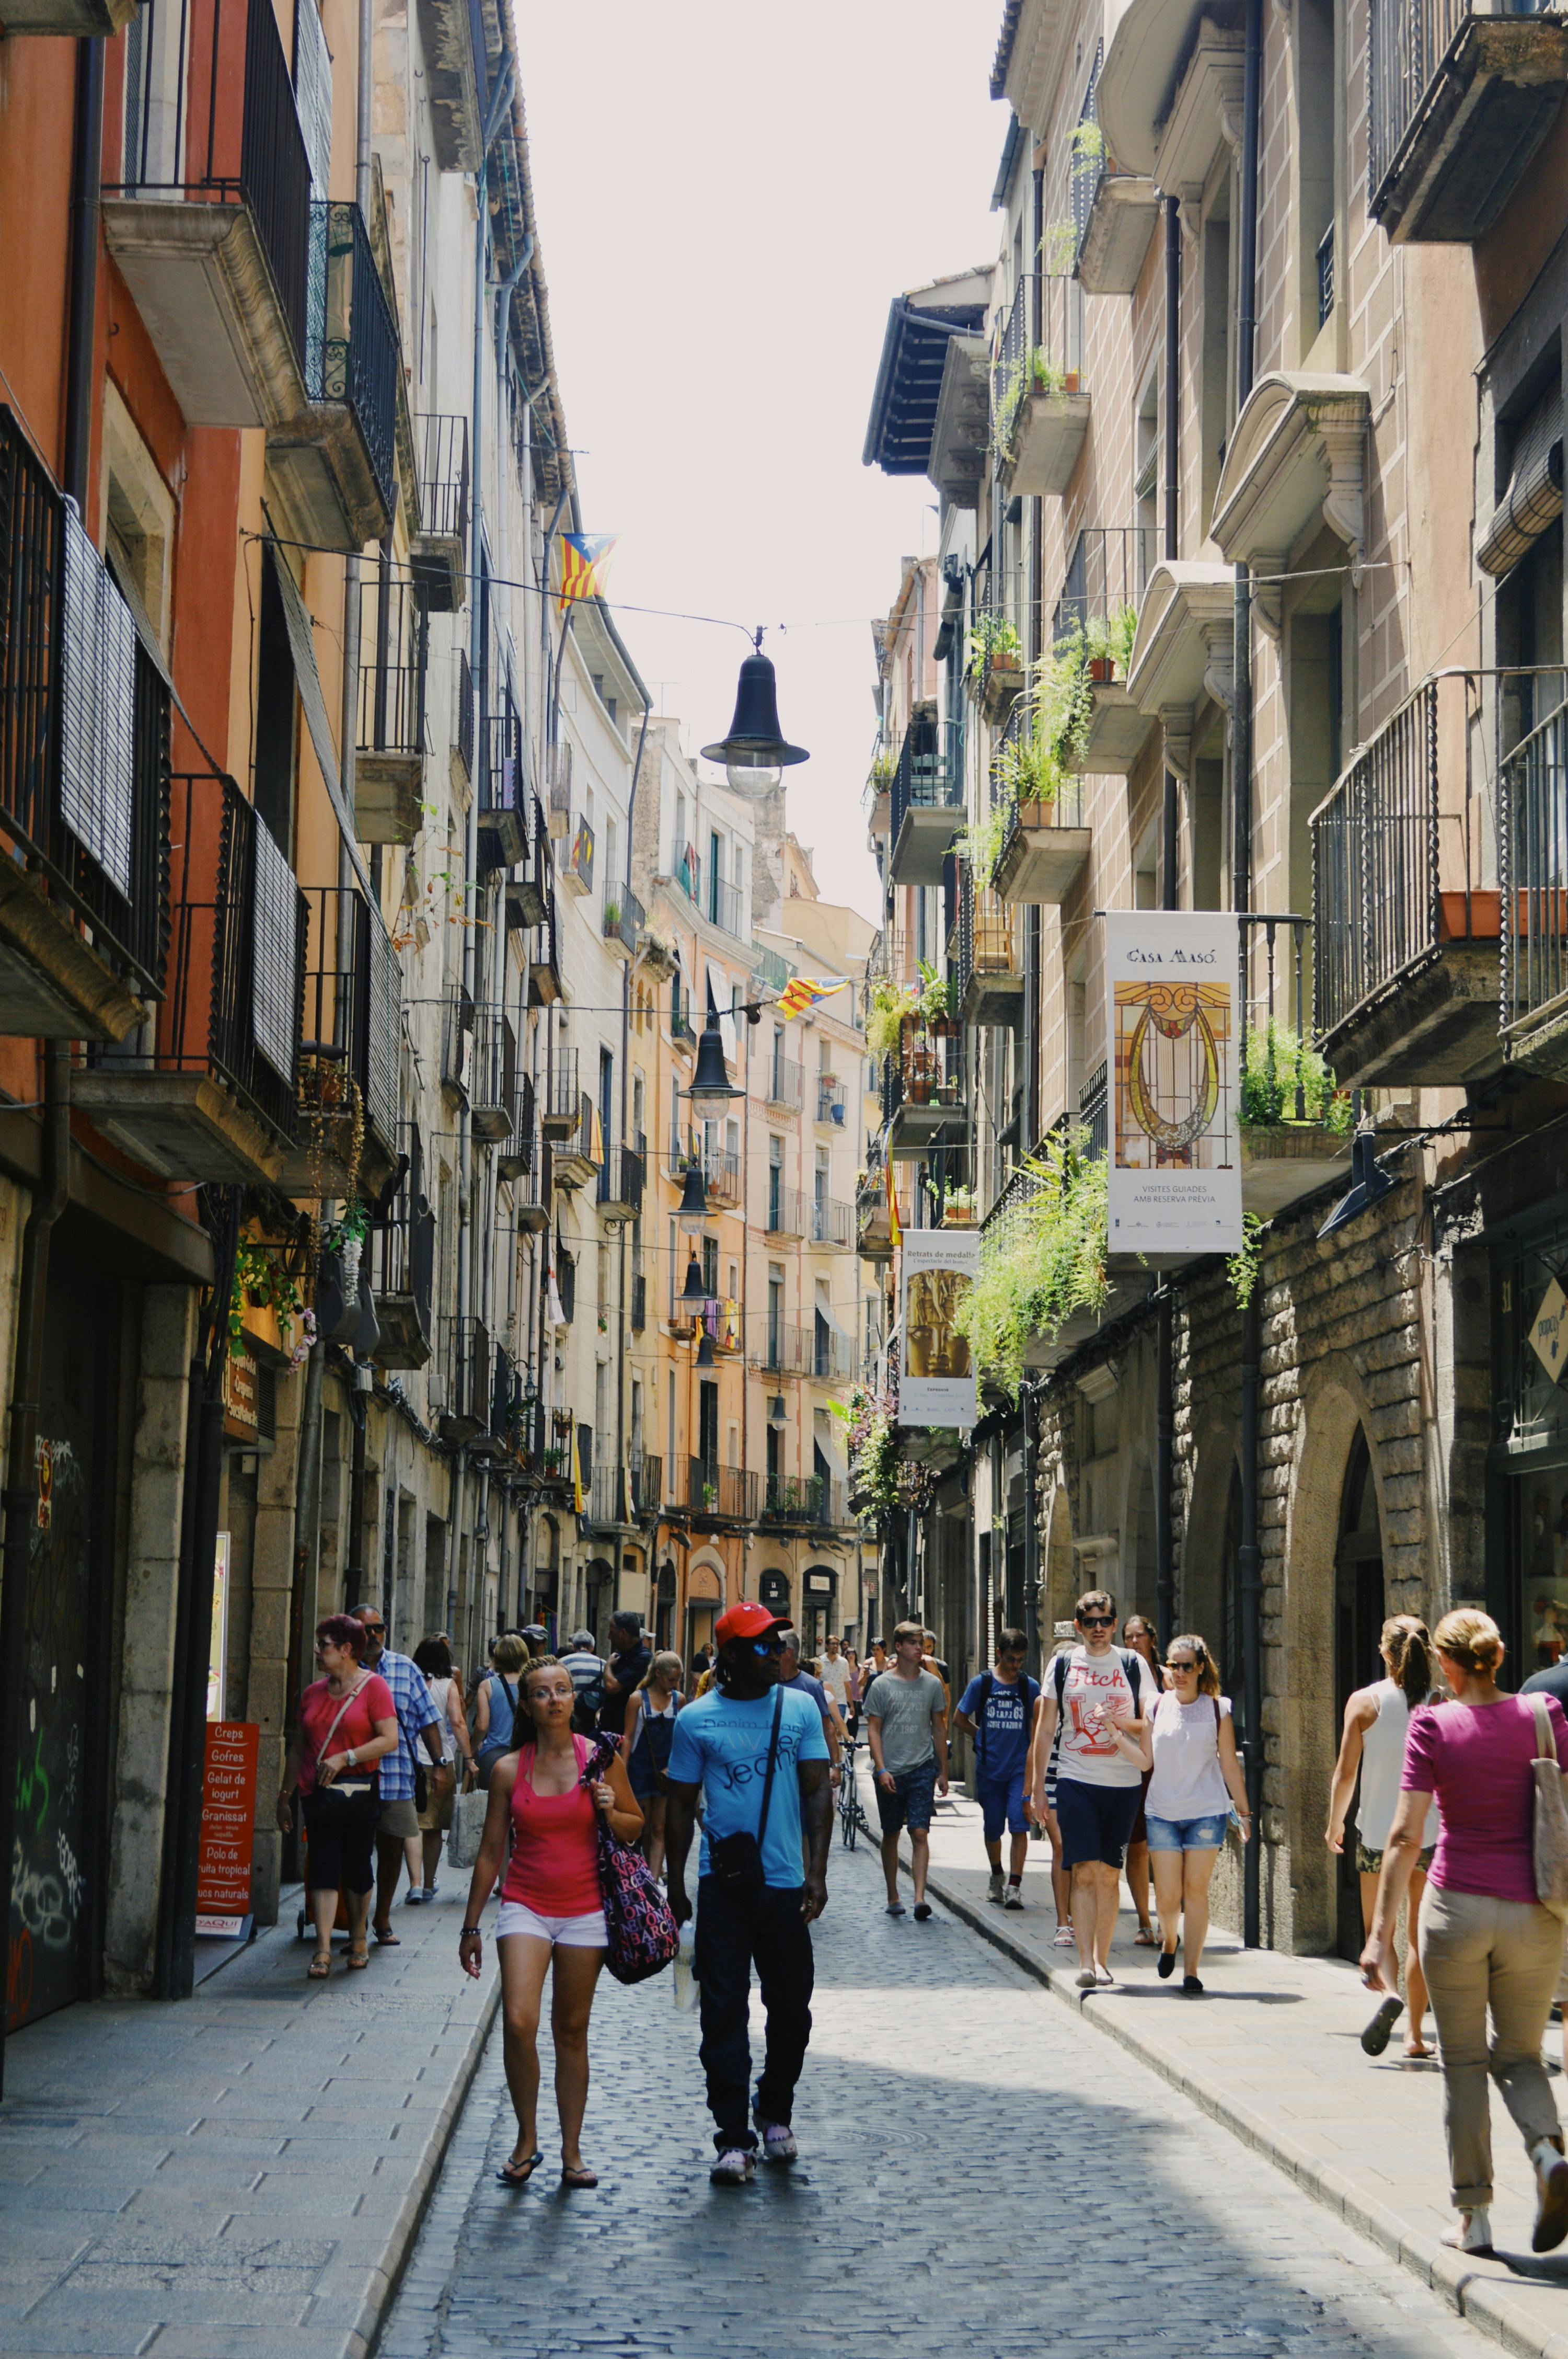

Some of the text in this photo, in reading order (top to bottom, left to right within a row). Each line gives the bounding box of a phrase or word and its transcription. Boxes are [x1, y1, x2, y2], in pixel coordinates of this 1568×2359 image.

[1188, 1194, 1216, 1203] PRÈVIA
[1502, 1279, 1512, 1314] 31
[997, 1700, 1012, 1709] SAINT
[1013, 1706, 1024, 1720] 63
[704, 1717, 757, 1728] Denim
[214, 1726, 244, 1742] Creps
[211, 1749, 244, 1762] Gofres
[207, 1771, 246, 1785] Gelat de
[212, 1788, 239, 1802] iogurt
[202, 1809, 247, 1823] Granissat
[206, 1847, 238, 1860] Polo de
[218, 1862, 251, 1878] tropical
[214, 1887, 249, 1899] naturals
